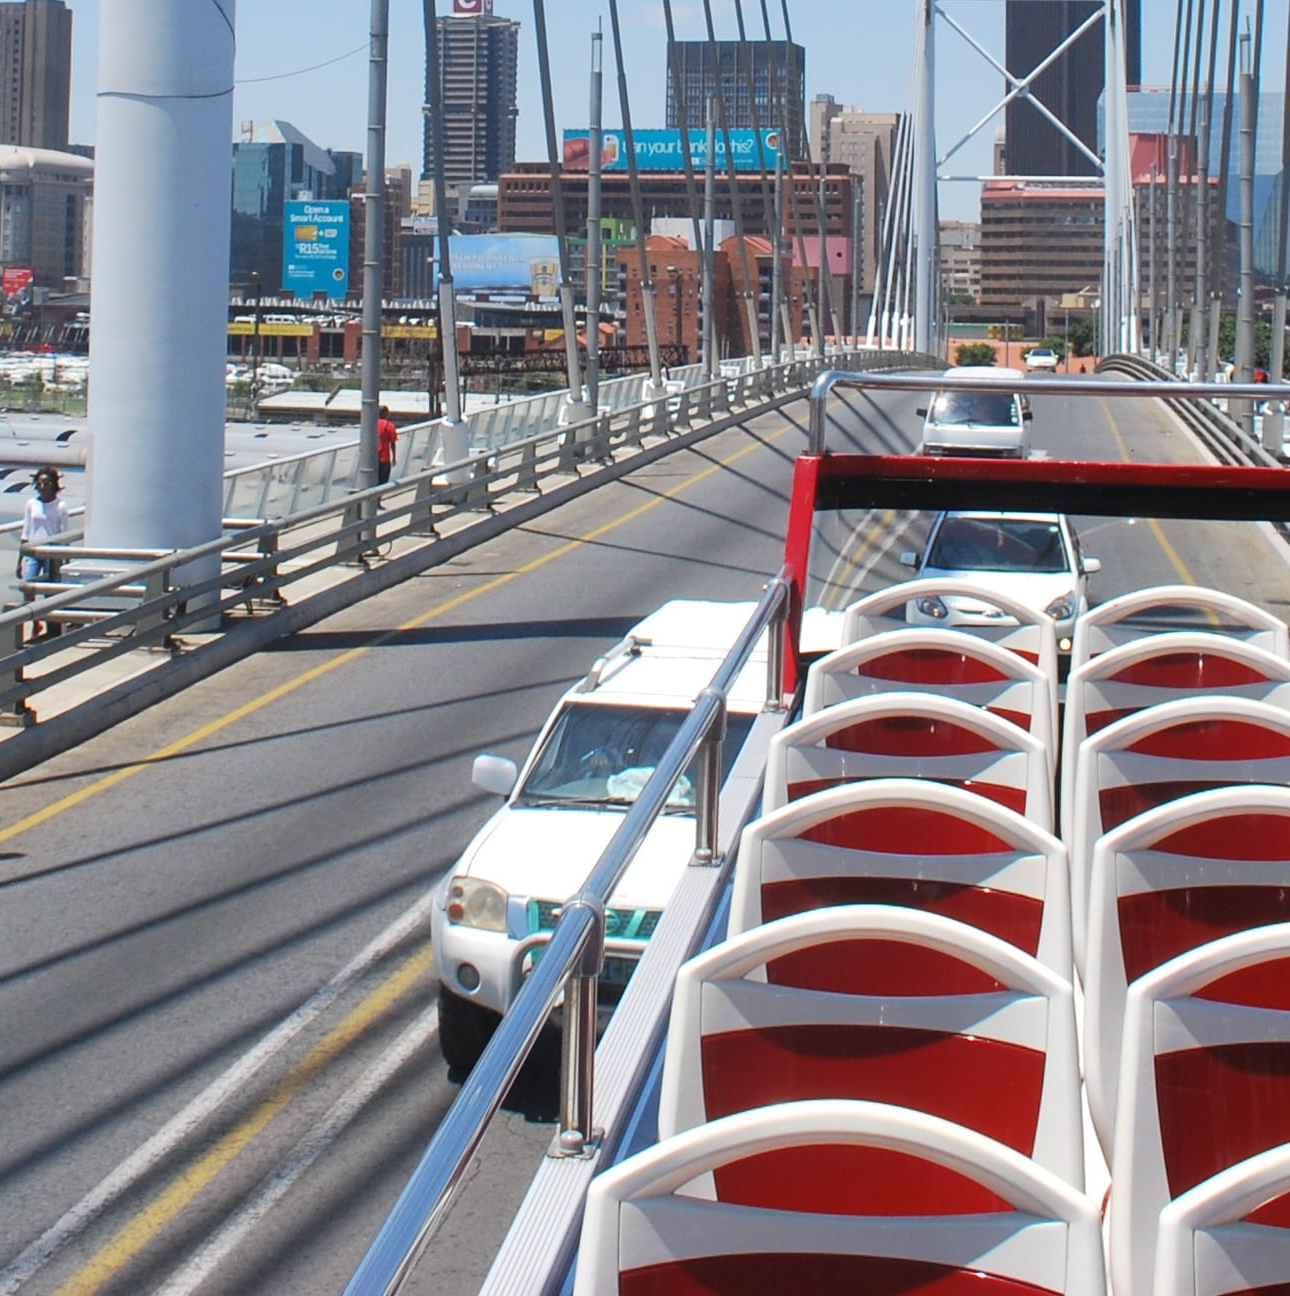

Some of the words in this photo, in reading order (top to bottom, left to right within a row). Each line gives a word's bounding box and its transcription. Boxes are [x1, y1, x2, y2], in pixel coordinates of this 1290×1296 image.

[648, 142, 676, 157] your
[730, 139, 754, 153] his?
[304, 205, 322, 214] Open
[290, 214, 312, 222] Smart
[313, 214, 344, 222] Account
